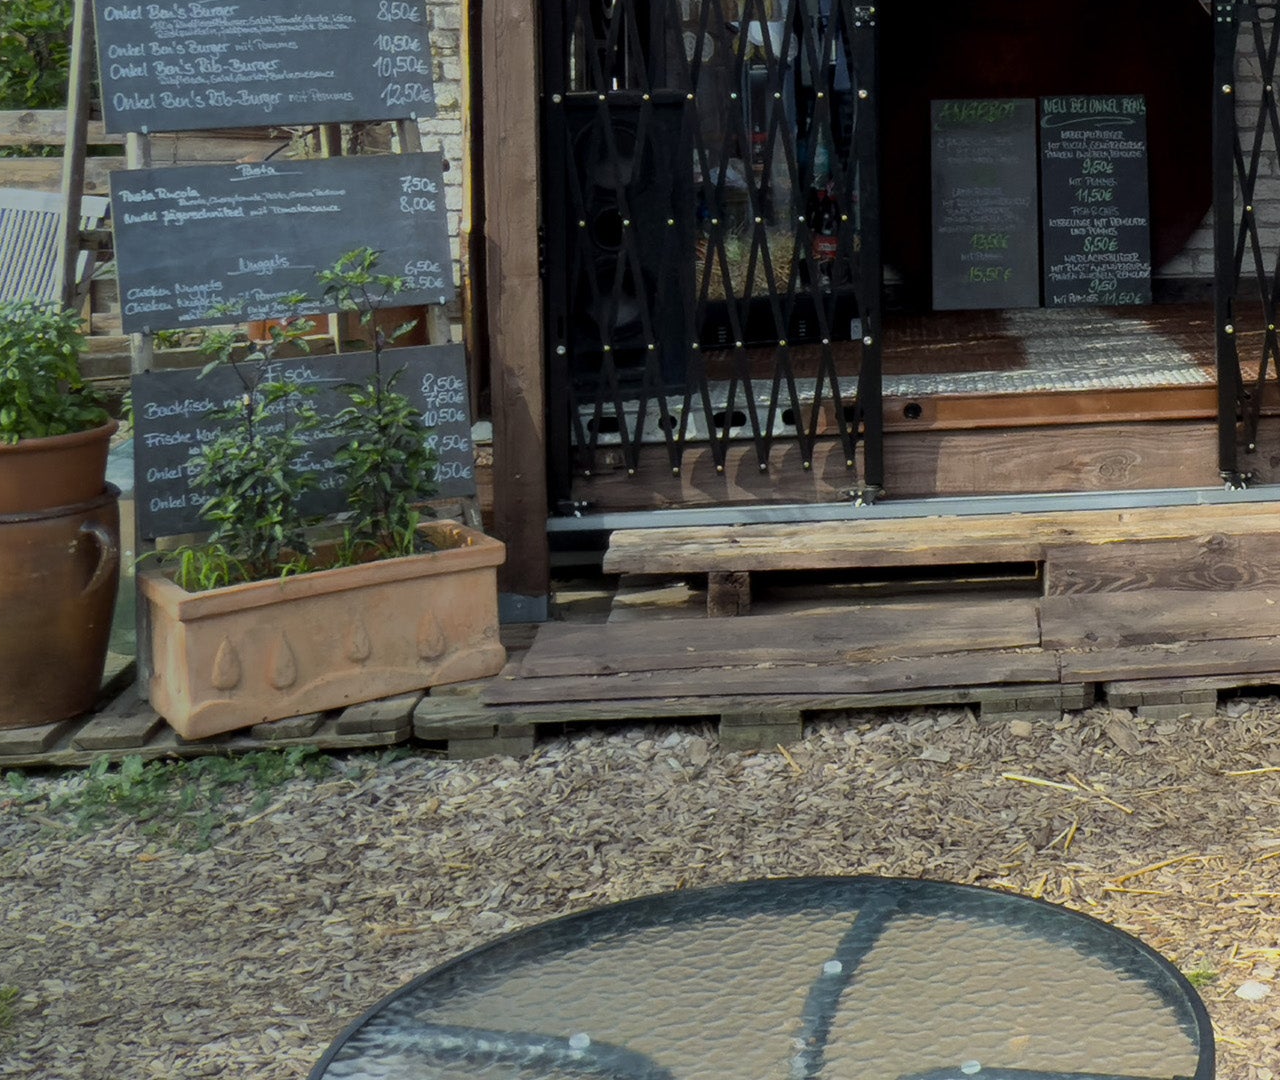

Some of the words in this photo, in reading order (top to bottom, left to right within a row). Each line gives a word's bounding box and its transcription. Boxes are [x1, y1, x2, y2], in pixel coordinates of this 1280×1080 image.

[104, 5, 142, 21] Onkel
[146, 3, 187, 19] Ben's
[188, 2, 240, 18] Burger
[377, 0, 422, 22] 8,50€
[108, 43, 146, 59] Onkel
[149, 40, 185, 56] Ben's
[185, 40, 231, 60] Burger
[373, 34, 422, 53] 10,50€
[110, 62, 149, 80] Onkel
[153, 59, 196, 76] Ben's
[195, 57, 281, 74] Rib-Burger
[372, 56, 429, 77] 10,50€
[113, 92, 157, 111] Onkel
[160, 90, 205, 109] Ben's
[205, 89, 283, 113] Rib-Burger
[380, 82, 433, 107] 12,50€
[1044, 97, 1067, 114] NEU
[1070, 97, 1088, 114] BEI
[236, 164, 277, 176] Pasta
[1082, 158, 1114, 174] 9,50€
[118, 189, 155, 202] Pasta
[155, 186, 201, 200] Rucola
[400, 175, 439, 193] 7,50€
[1075, 188, 1114, 204] 11,50€
[399, 196, 437, 214] 8,00€
[1083, 236, 1118, 252] 8,50€
[239, 254, 290, 276] Nuggets
[126, 285, 172, 300] Chicken
[174, 279, 224, 299] Nuggets
[404, 260, 442, 275] 6,50€
[125, 300, 173, 315] Chicken
[264, 363, 320, 384] Fisch
[420, 373, 465, 394] 8,50€
[143, 397, 218, 420] Backfisch
[423, 391, 465, 408] 7,50€
[143, 431, 193, 448] Frische
[420, 408, 466, 427] 10,50€
[147, 465, 182, 483] Onkel
[150, 494, 187, 512] Onkel
